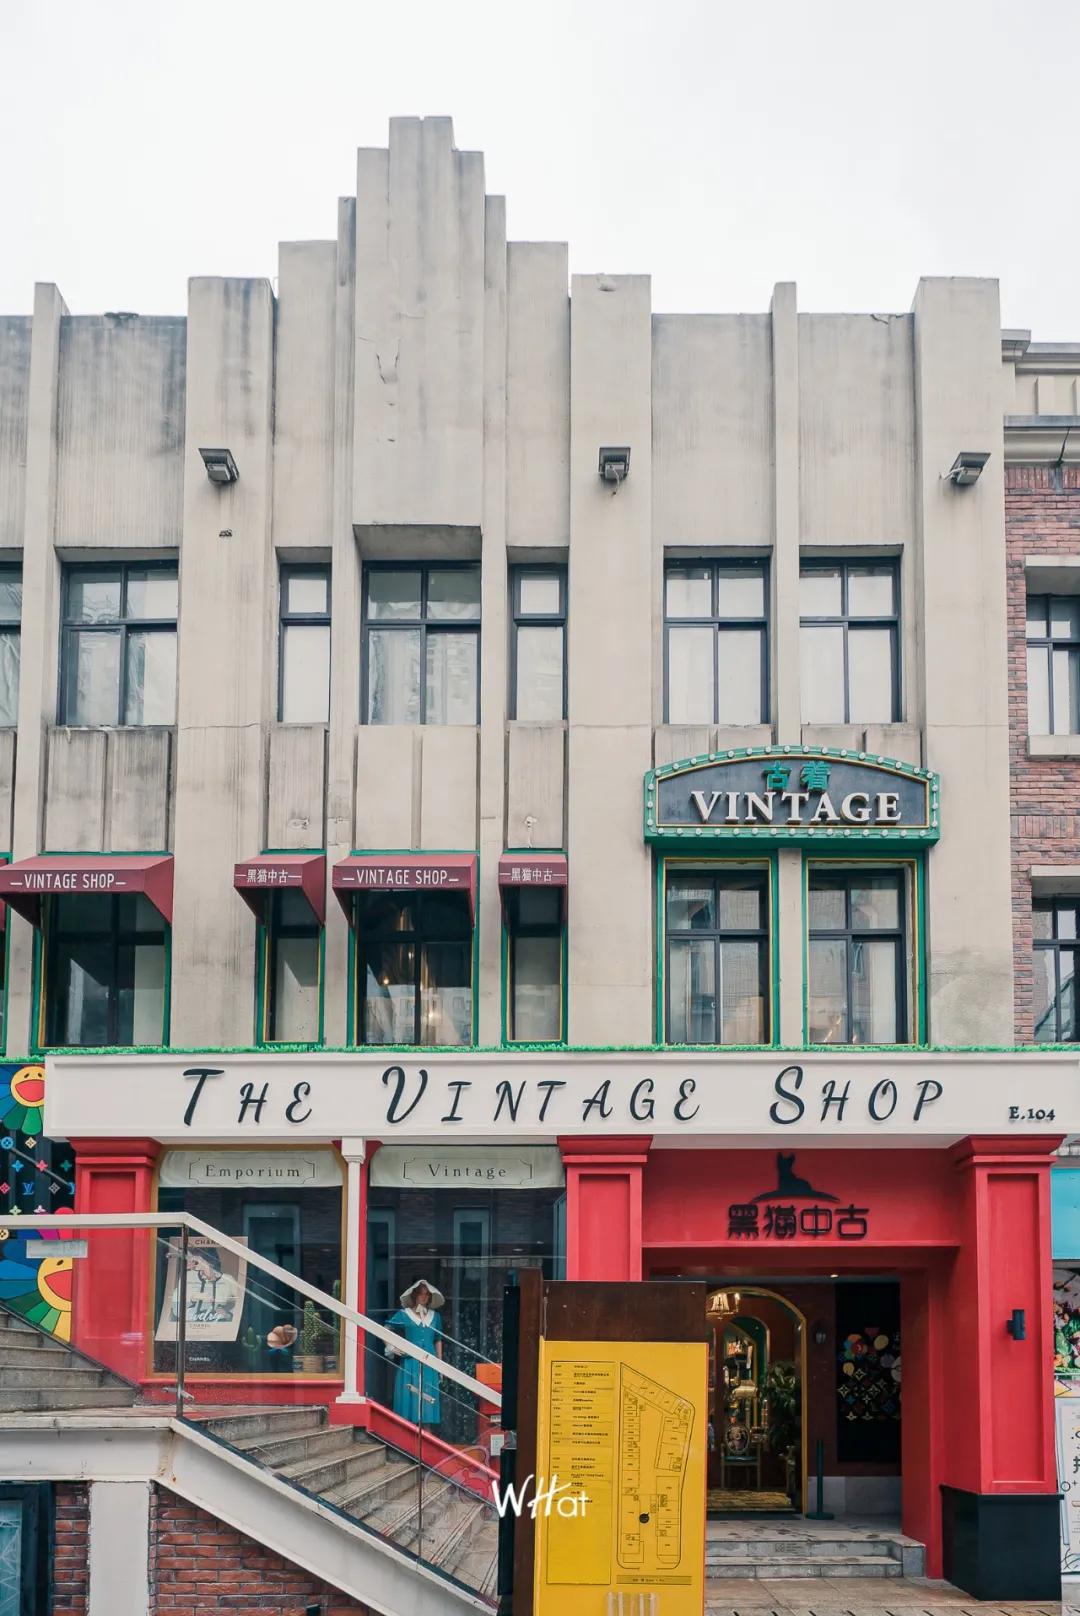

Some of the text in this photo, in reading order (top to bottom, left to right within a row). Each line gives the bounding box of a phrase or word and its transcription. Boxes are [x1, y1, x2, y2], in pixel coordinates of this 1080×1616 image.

[763, 760, 832, 792] 古着
[691, 791, 902, 825] VINTAGE
[24, 872, 115, 889] VINTAGE SHOP
[247, 868, 288, 883] 黑猫中古
[356, 870, 448, 885] VINTAGE SHOP
[511, 867, 553, 882] 黑猫中古
[182, 1065, 943, 1126] THE VINTAGE SHOP
[1008, 1106, 1056, 1121] E.104
[205, 1163, 302, 1180] Emporium
[428, 1163, 508, 1180] Vintage
